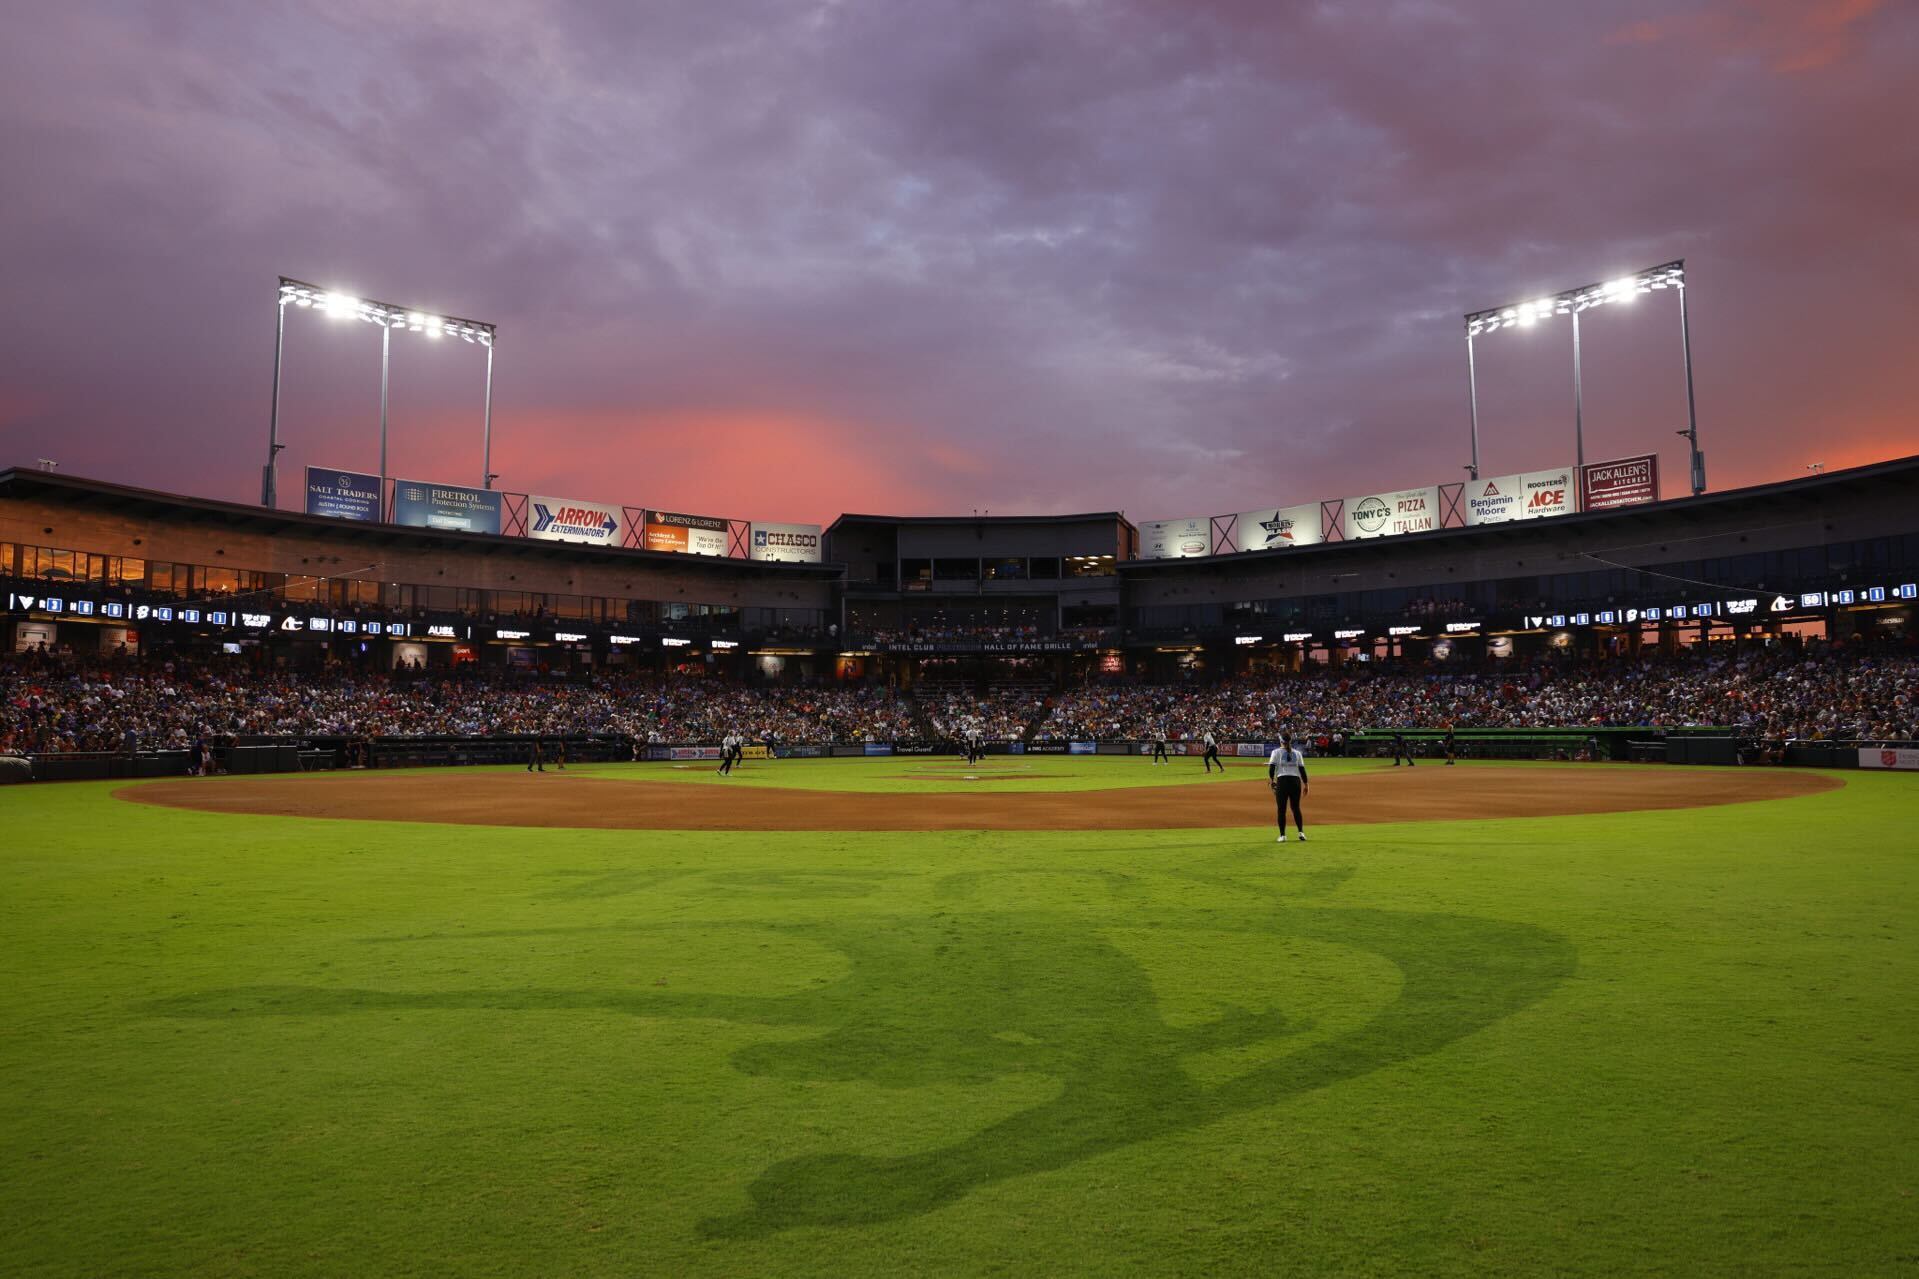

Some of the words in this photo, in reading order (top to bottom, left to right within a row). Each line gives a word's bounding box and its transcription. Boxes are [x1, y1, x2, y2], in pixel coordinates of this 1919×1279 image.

[1592, 469, 1613, 482] JACK
[1613, 464, 1647, 478] ALLEN'S
[1527, 479, 1562, 489] ROOSTERS
[1613, 476, 1647, 486] KITCHEN
[310, 485, 333, 494] SALT
[336, 488, 378, 500] TRADERS
[431, 489, 480, 503] FIRETROL
[1528, 489, 1565, 508] ACE
[431, 497, 467, 508] Protection
[469, 503, 495, 511] Systems
[1398, 499, 1426, 513] PIZZA
[1470, 495, 1513, 508] Benjamin
[1352, 510, 1376, 520] TONY
[1376, 507, 1391, 517] C'S
[1476, 506, 1506, 516] Moore
[1528, 505, 1565, 514] Hardware
[554, 507, 608, 528] ARROW
[665, 515, 691, 524] LORENZ
[697, 519, 721, 528] LORENZ
[551, 524, 605, 538] EXTERMINATORS
[1393, 517, 1432, 533] ITALIAN
[768, 533, 817, 547] CHASCO
[755, 546, 816, 555] CONSTRUCTORS
[101, 605, 107, 613] E
